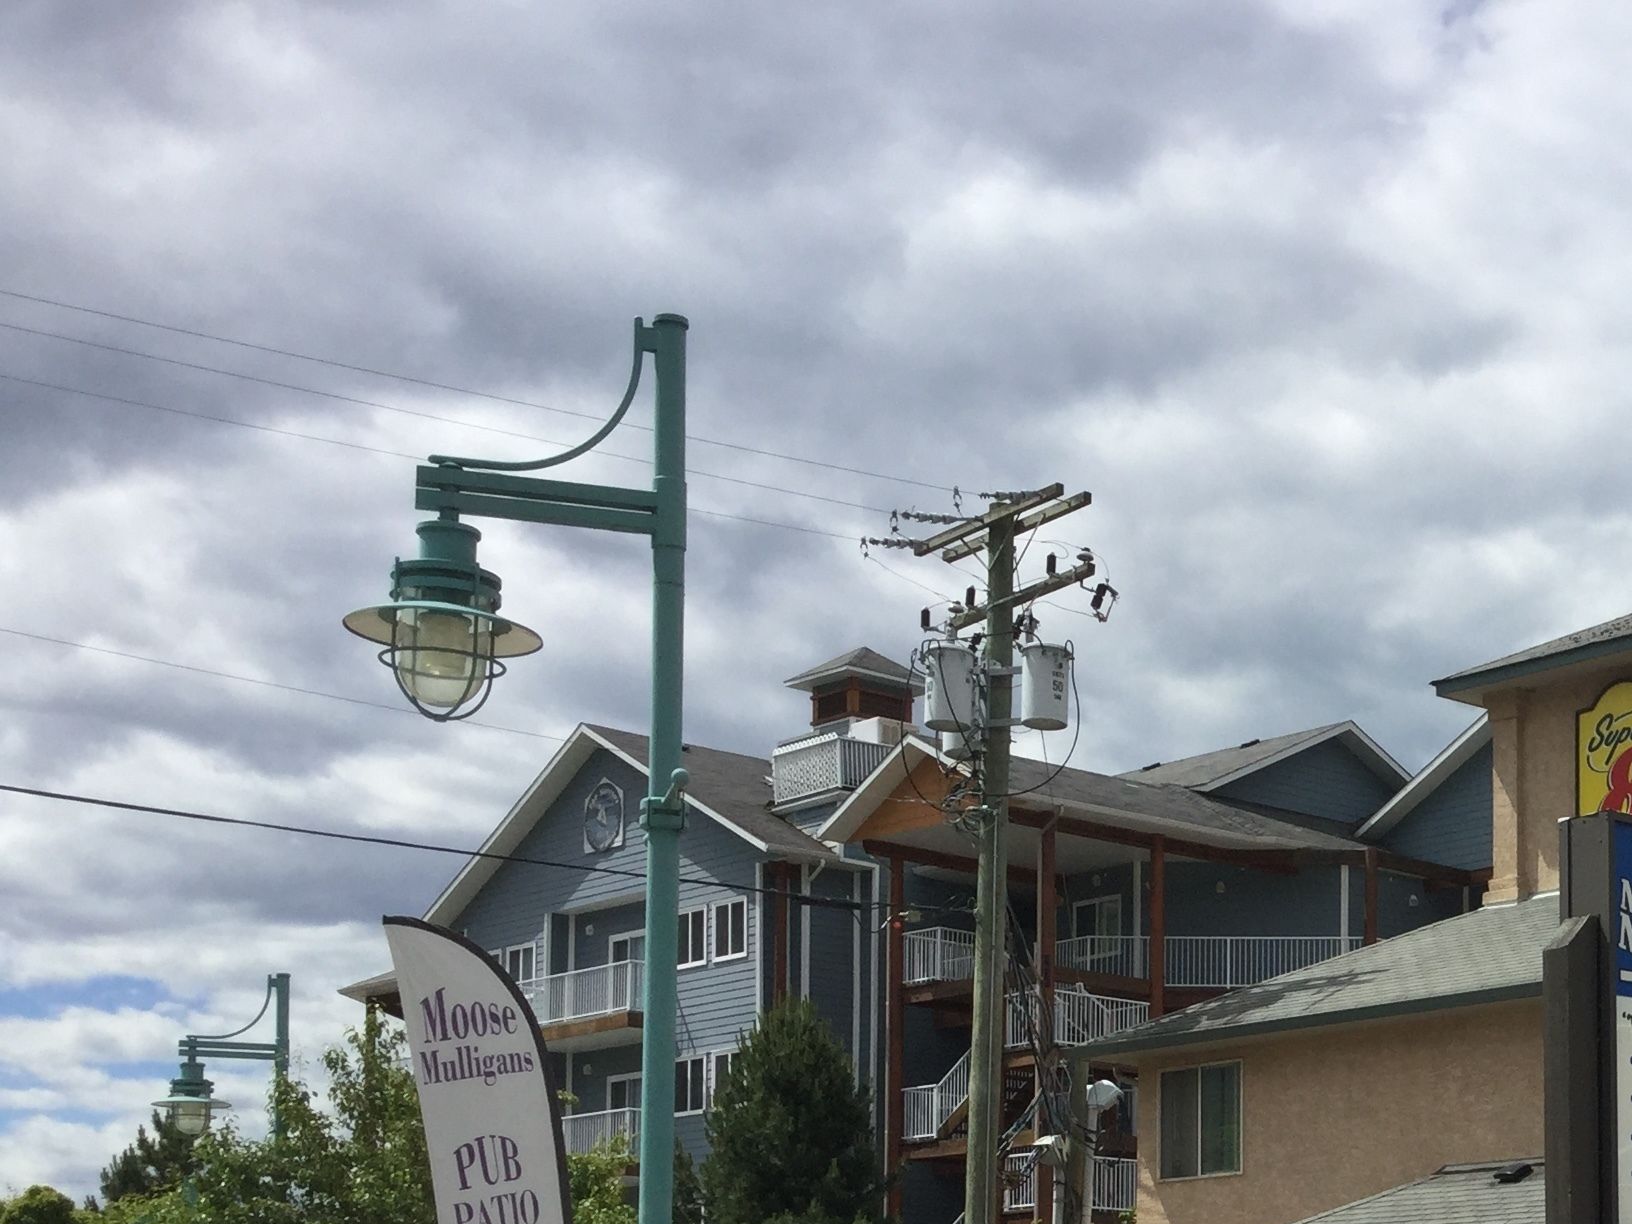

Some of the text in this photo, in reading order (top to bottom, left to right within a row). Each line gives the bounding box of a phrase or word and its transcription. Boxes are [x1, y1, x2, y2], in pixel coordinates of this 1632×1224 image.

[420, 987, 518, 1043] Moose
[420, 1045, 534, 1086] Mulligans
[453, 1134, 522, 1190] PUB
